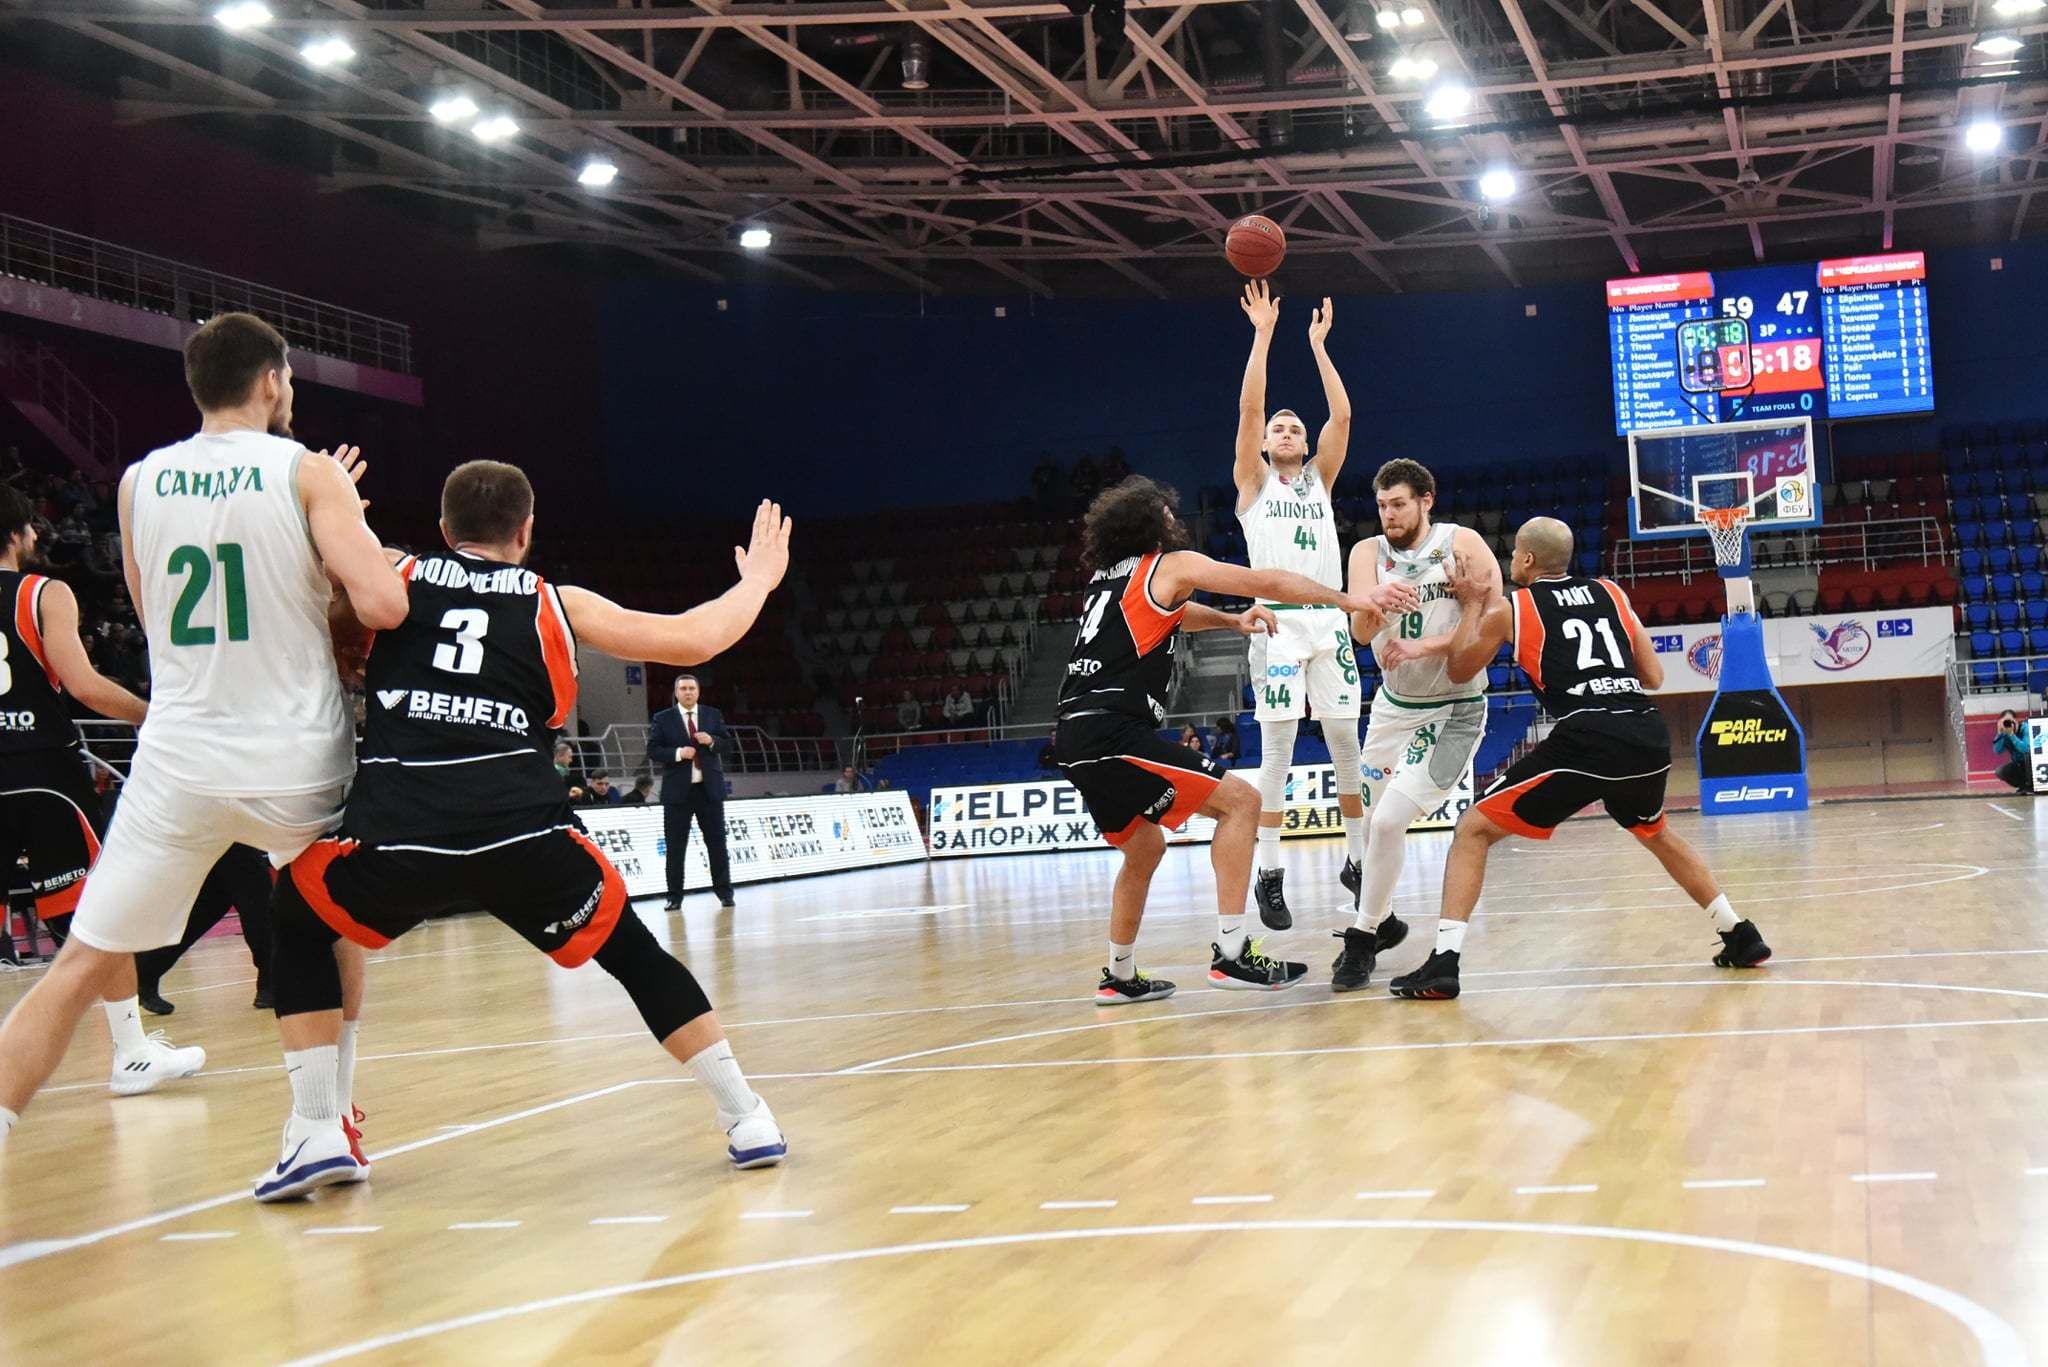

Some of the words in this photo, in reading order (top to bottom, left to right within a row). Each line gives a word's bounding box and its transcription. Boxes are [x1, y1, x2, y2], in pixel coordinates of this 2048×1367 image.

[1822, 287, 1835, 295] No
[1839, 284, 1864, 293] Player
[1866, 282, 1890, 290] Name
[1629, 304, 1653, 313] Player
[1655, 301, 1679, 309] Name
[1722, 296, 1754, 319] 59
[1776, 291, 1809, 315] 47
[1759, 323, 1777, 337] 3P
[1752, 405, 1772, 413] TEAM
[1773, 403, 1796, 411] FOULS
[1800, 393, 1813, 411] 0
[156, 466, 264, 504] САНДУЛ
[1783, 504, 1804, 513] ФБУ
[1294, 525, 1317, 551] 44
[167, 543, 249, 647] 21
[1400, 610, 1423, 639] 19
[1881, 621, 1889, 630] 6
[432, 608, 489, 675] 3
[1562, 618, 1626, 671] 21
[1265, 683, 1291, 709] 44
[1588, 677, 1642, 693] ВЕНЕТ
[407, 711, 441, 721] НАША
[445, 714, 477, 726] СИЛА
[409, 690, 530, 729] ВЕНЕТО
[1710, 718, 1762, 734] PARI
[1718, 728, 1787, 746] MATCH
[1714, 786, 1794, 803] elan
[758, 814, 816, 839] HELPER
[858, 806, 907, 829] HELPER
[43, 867, 87, 889] ВЕНЕТО
